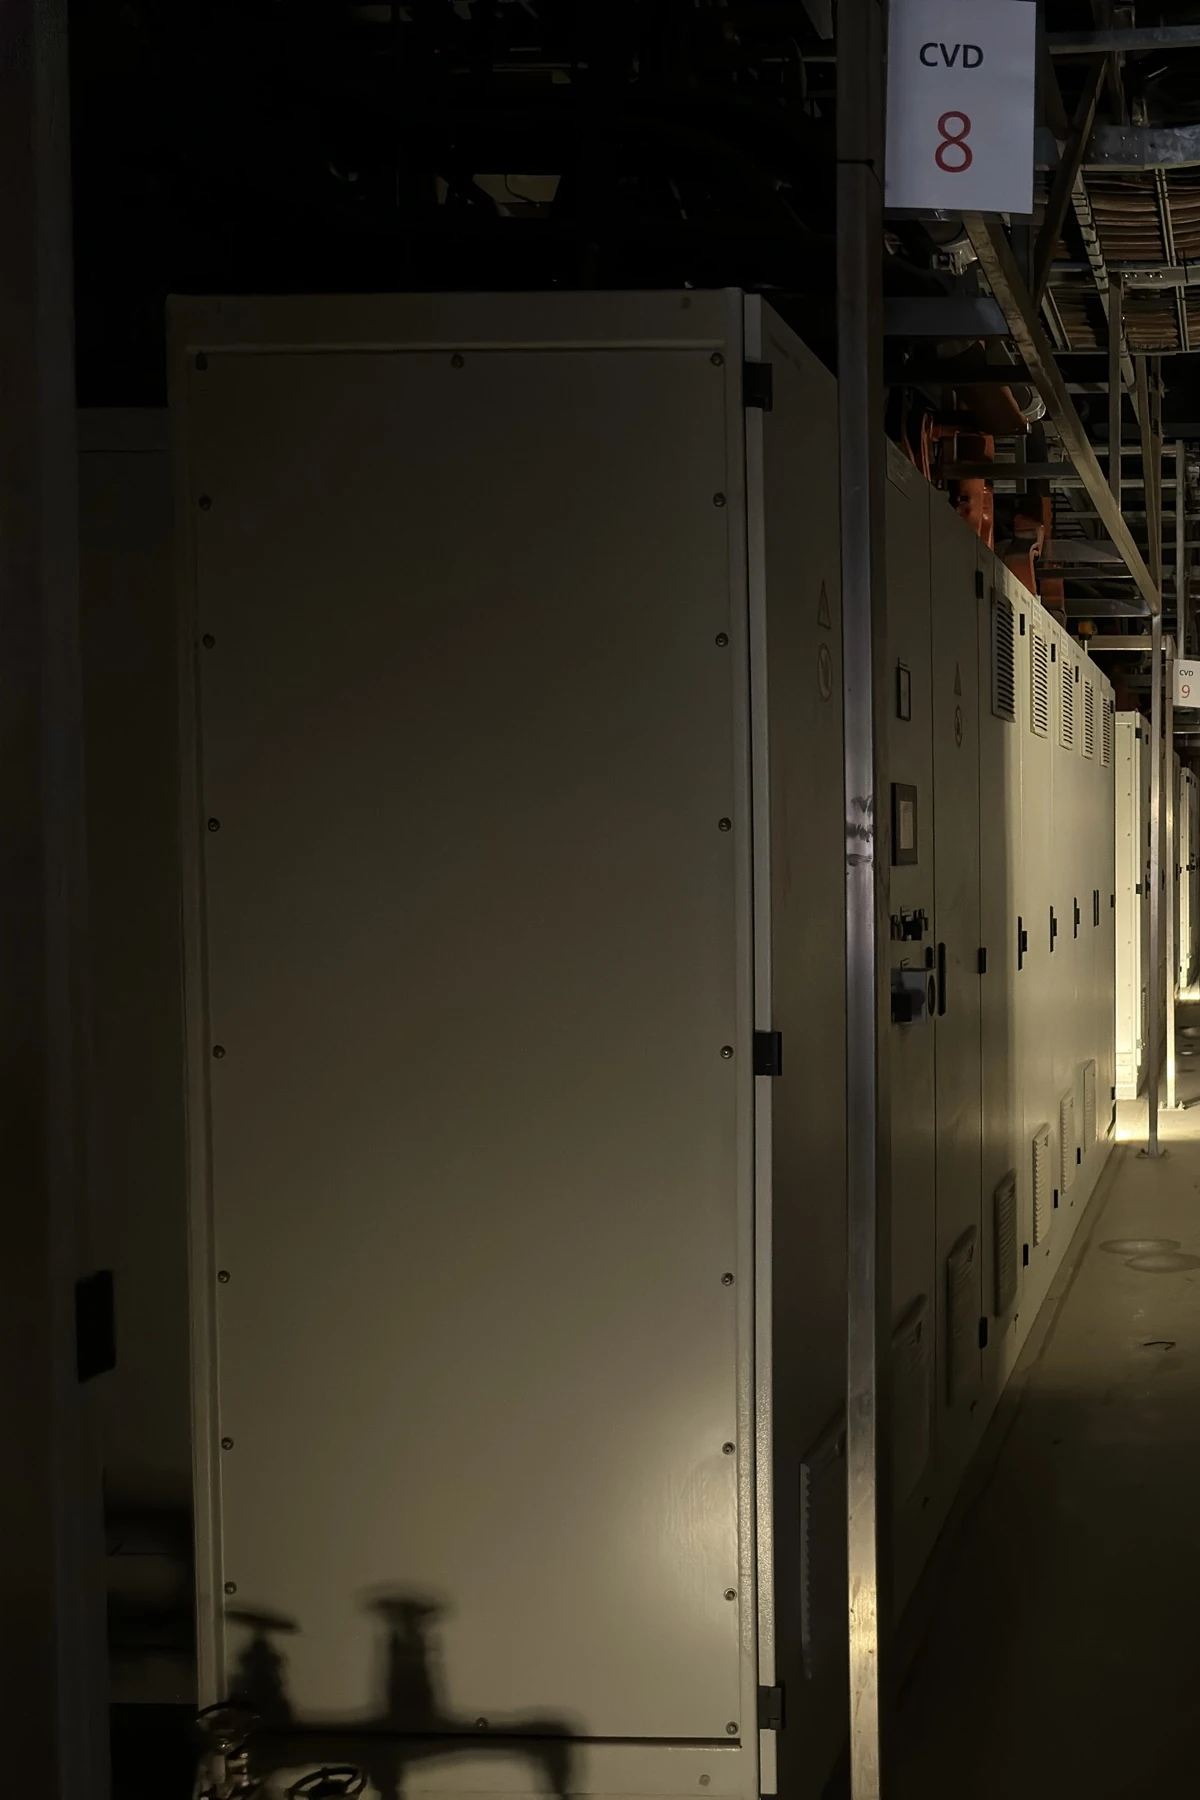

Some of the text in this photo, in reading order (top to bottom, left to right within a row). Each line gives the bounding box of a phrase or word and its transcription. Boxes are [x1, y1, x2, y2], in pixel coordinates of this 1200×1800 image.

[919, 42, 984, 69] CVD
[934, 110, 973, 173] 8
[1179, 669, 1194, 677] CVD
[1181, 684, 1191, 699] 9
